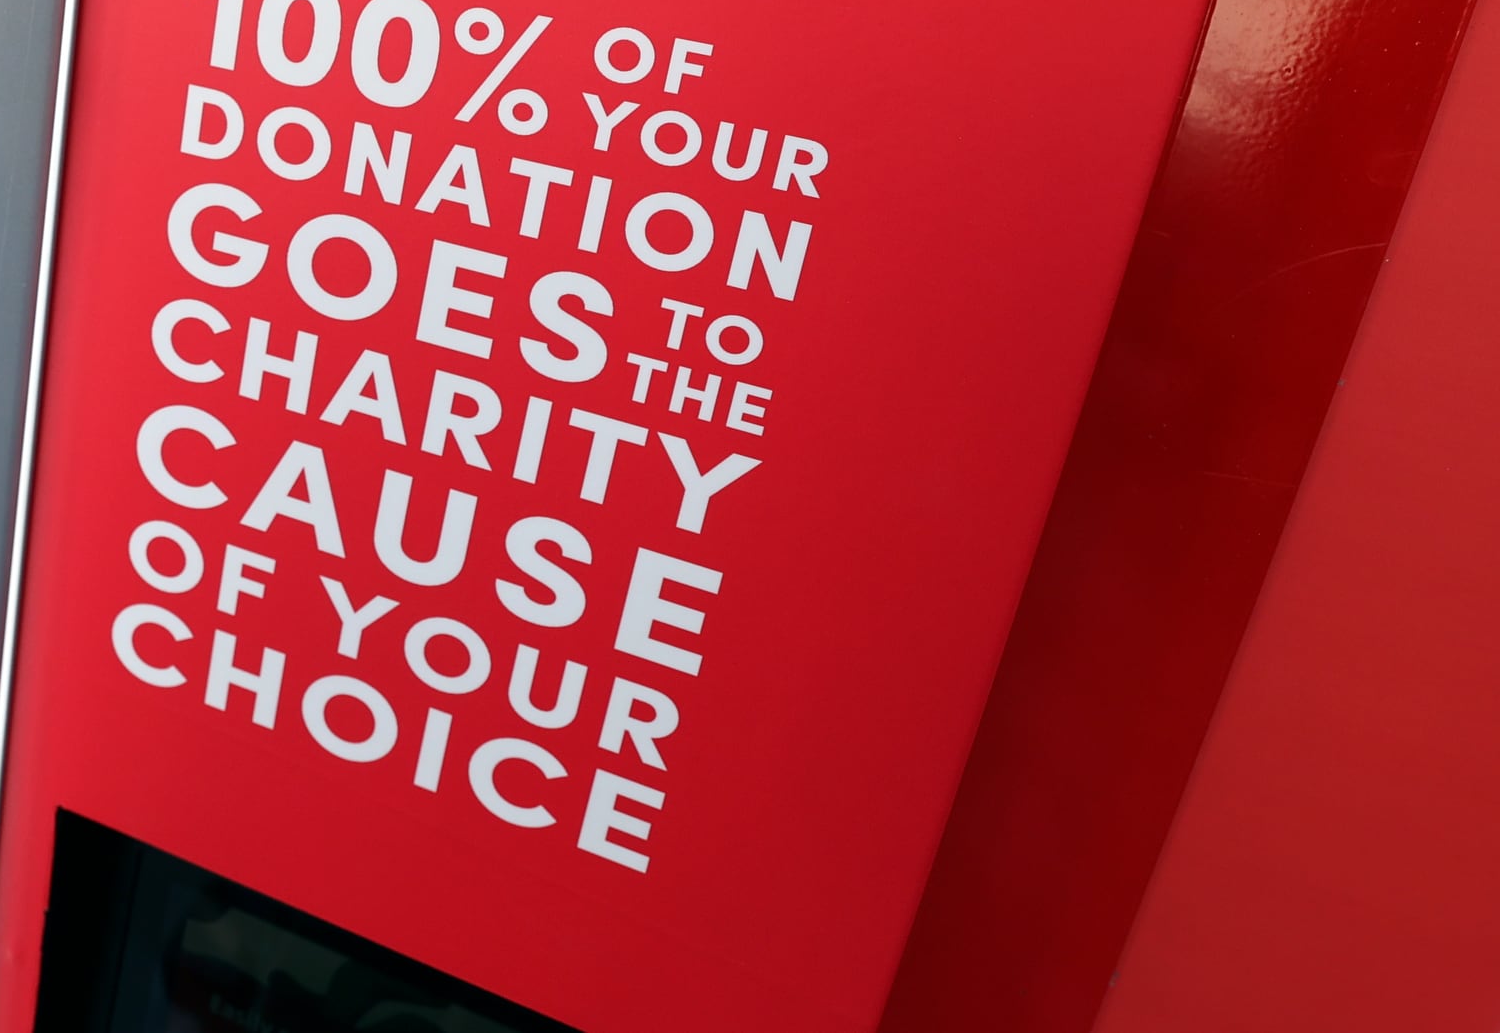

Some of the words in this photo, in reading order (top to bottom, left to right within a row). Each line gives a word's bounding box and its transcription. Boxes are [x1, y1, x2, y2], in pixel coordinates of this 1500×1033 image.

[583, 93, 828, 198] YOUR
[594, 27, 713, 94] OF
[168, 183, 613, 382] GOES
[181, 84, 812, 301] DONATION
[152, 299, 761, 533] CHARITY
[627, 353, 772, 435] THE
[662, 298, 763, 365] TO
[137, 405, 722, 675] CAUSE
[112, 604, 664, 872] CHOICE
[129, 521, 275, 615] OF
[321, 576, 678, 770] YOUR
